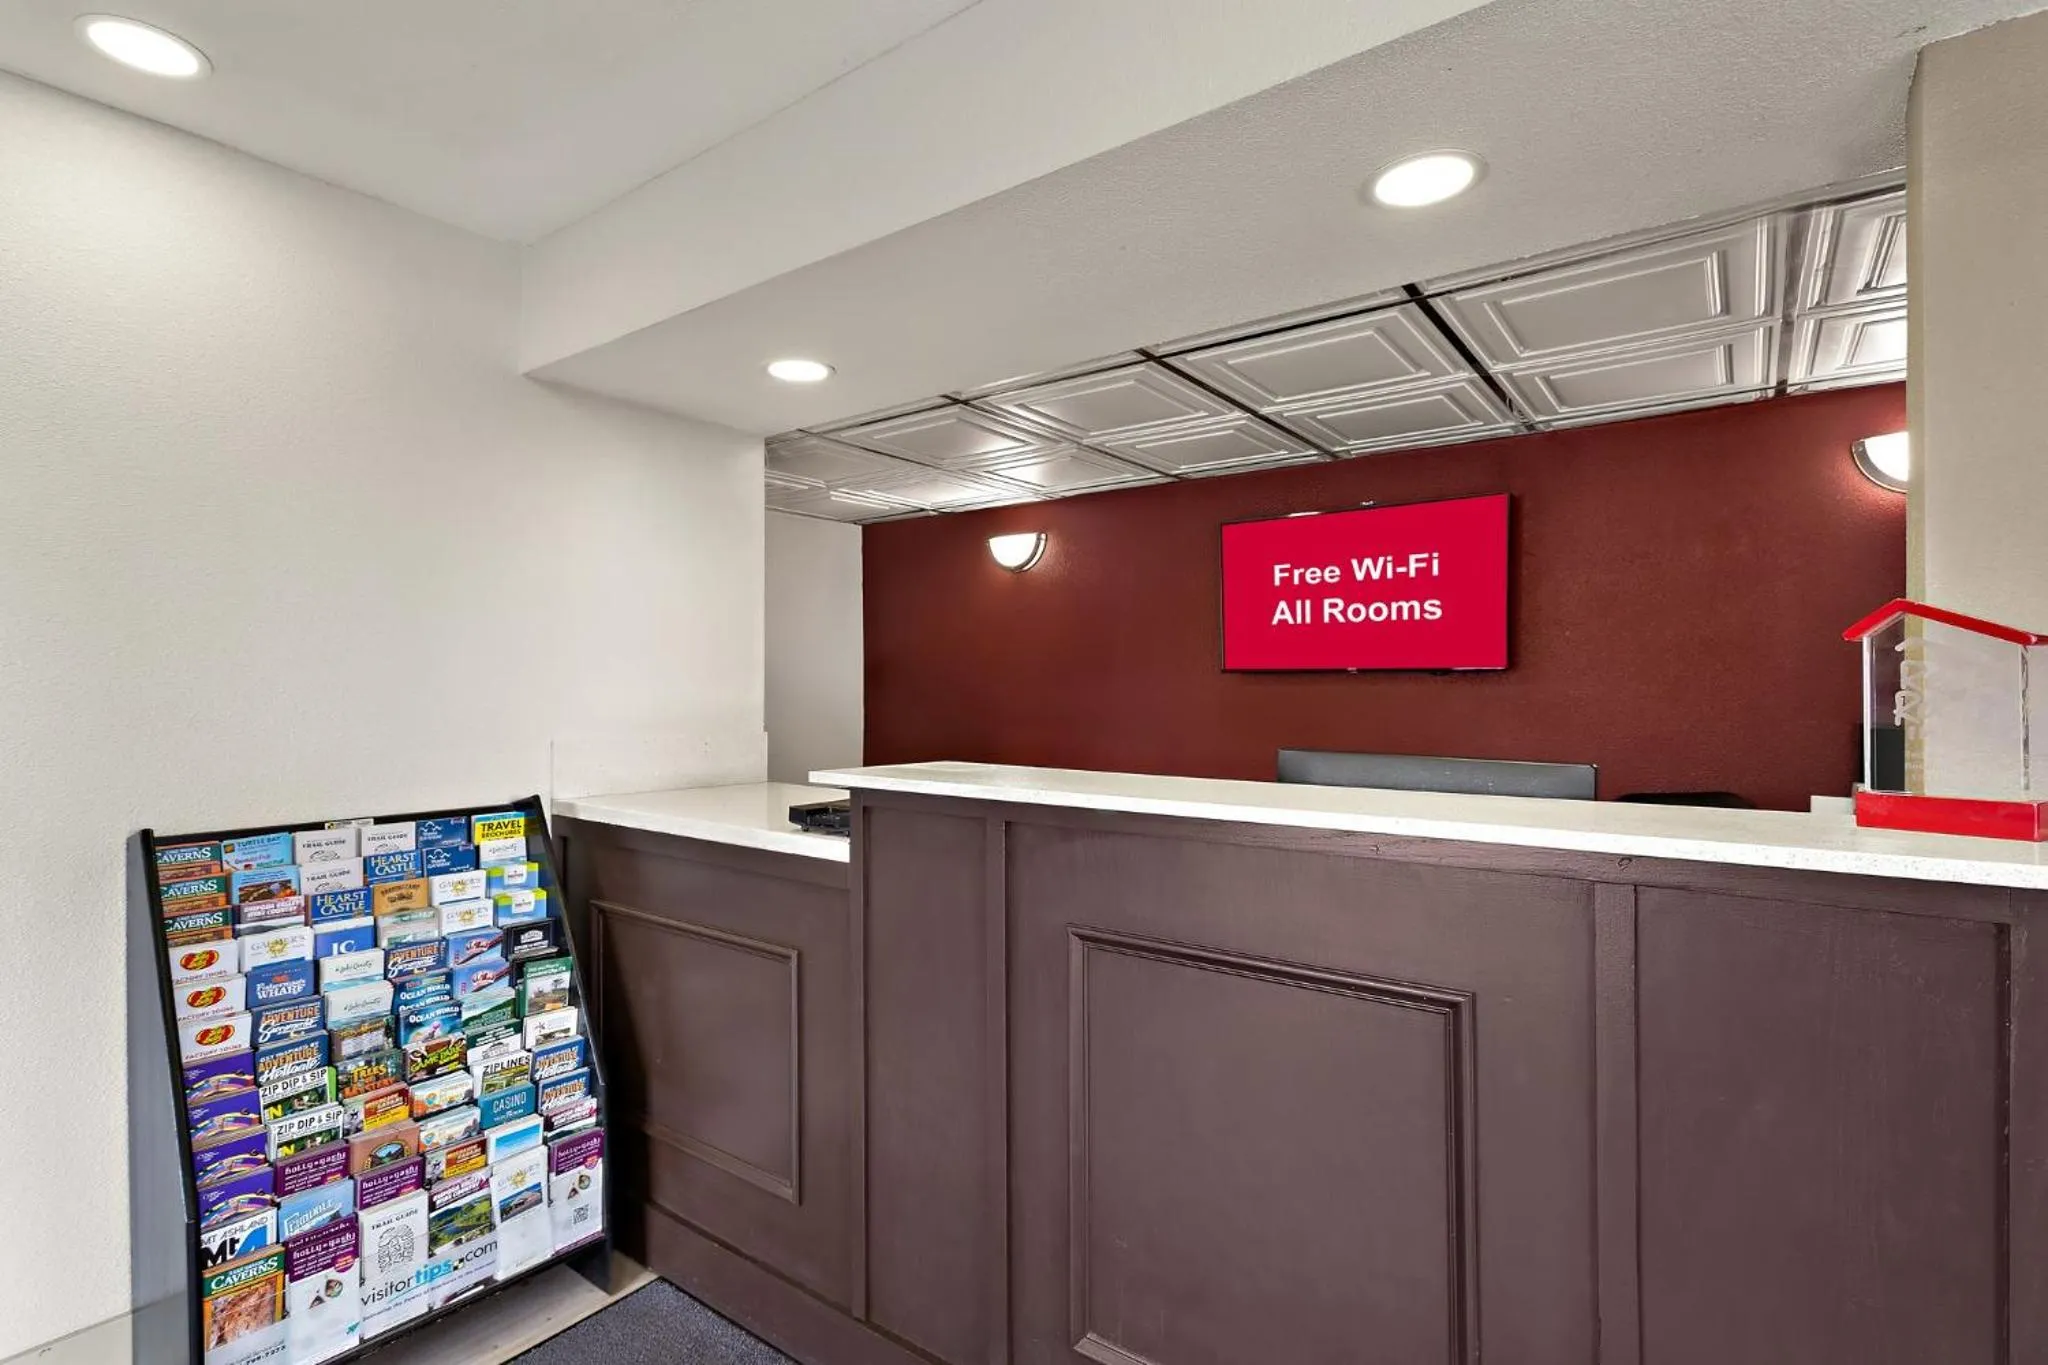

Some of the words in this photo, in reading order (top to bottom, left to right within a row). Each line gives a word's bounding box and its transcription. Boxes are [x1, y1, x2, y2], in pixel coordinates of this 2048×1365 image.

[1273, 563, 1341, 586] Free
[1351, 552, 1440, 581] Wi-Fi
[1271, 600, 1311, 625] All
[1323, 598, 1443, 624] Rooms
[481, 819, 522, 832] TRAVEL
[481, 829, 521, 839] BROCHURES
[371, 852, 416, 867] HEARST
[374, 862, 417, 876] CASTLE
[316, 890, 365, 906] HEARST
[320, 901, 366, 916] CASTLE
[400, 989, 426, 1000] OCEAN
[260, 1006, 321, 1024] ADVENTURE
[409, 1012, 435, 1023] OCEAN
[436, 1006, 460, 1016] WORLD
[258, 1047, 320, 1073] ADVENTURE
[483, 1054, 531, 1075] ZIPLINES
[261, 1085, 279, 1098] ZIP
[281, 1076, 300, 1089] DIP
[310, 1068, 327, 1081] SIP
[492, 1091, 527, 1113] CASINO
[277, 1122, 295, 1136] ZIP
[297, 1117, 316, 1129] DIP
[326, 1110, 343, 1122] SIP
[220, 1216, 268, 1240] ASHLAND
[371, 1217, 394, 1231] TRAIL
[211, 1256, 278, 1290] CAVERNS
